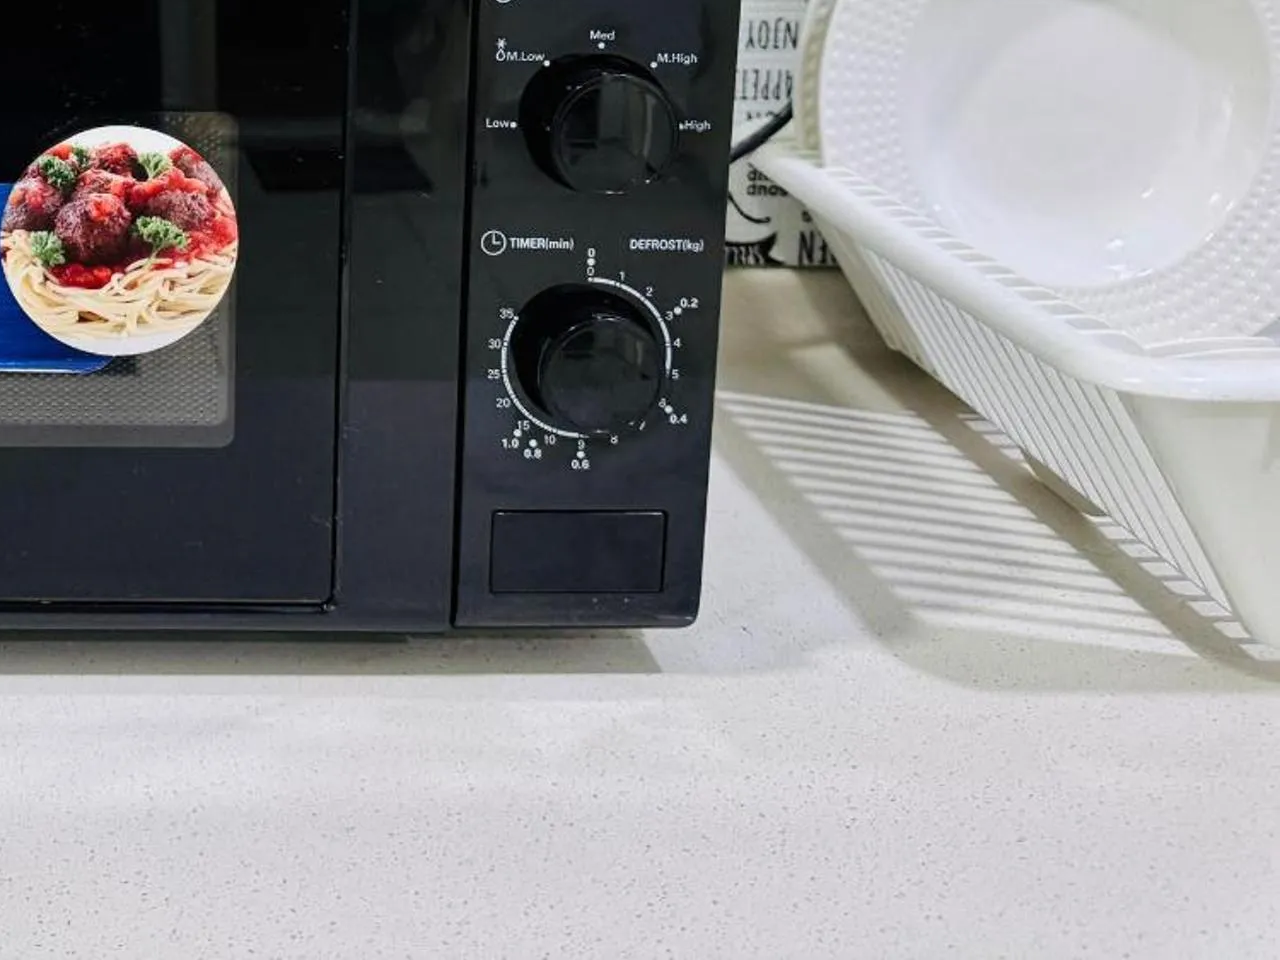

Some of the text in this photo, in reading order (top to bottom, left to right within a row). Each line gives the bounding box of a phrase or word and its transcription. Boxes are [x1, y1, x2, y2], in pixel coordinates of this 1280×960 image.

[589, 29, 616, 41] Med
[745, 18, 799, 50] NJOY
[505, 51, 545, 62] M.Low
[656, 52, 698, 65] M.High
[735, 69, 793, 100] APPET
[485, 117, 510, 129] Low
[684, 119, 711, 133] High
[509, 237, 575, 251] TIMER(min)
[629, 238, 705, 253] DEFROST(kg)
[587, 247, 596, 258] 0
[585, 266, 595, 277] 0
[619, 271, 626, 281] 1
[645, 286, 654, 298] 2
[680, 297, 699, 310] 0.2
[499, 307, 514, 321] 35
[664, 310, 674, 321] 3
[487, 337, 502, 350] 30
[673, 337, 682, 348] 4
[487, 368, 501, 380] 25
[671, 368, 680, 380] 5
[495, 397, 511, 409] 20
[669, 412, 688, 425] 0.4
[517, 419, 531, 431] 15
[501, 437, 520, 449] 1.0
[543, 433, 557, 446] 10
[577, 439, 586, 451] 9
[523, 447, 542, 460] 0.8
[570, 458, 590, 470] 0.6
